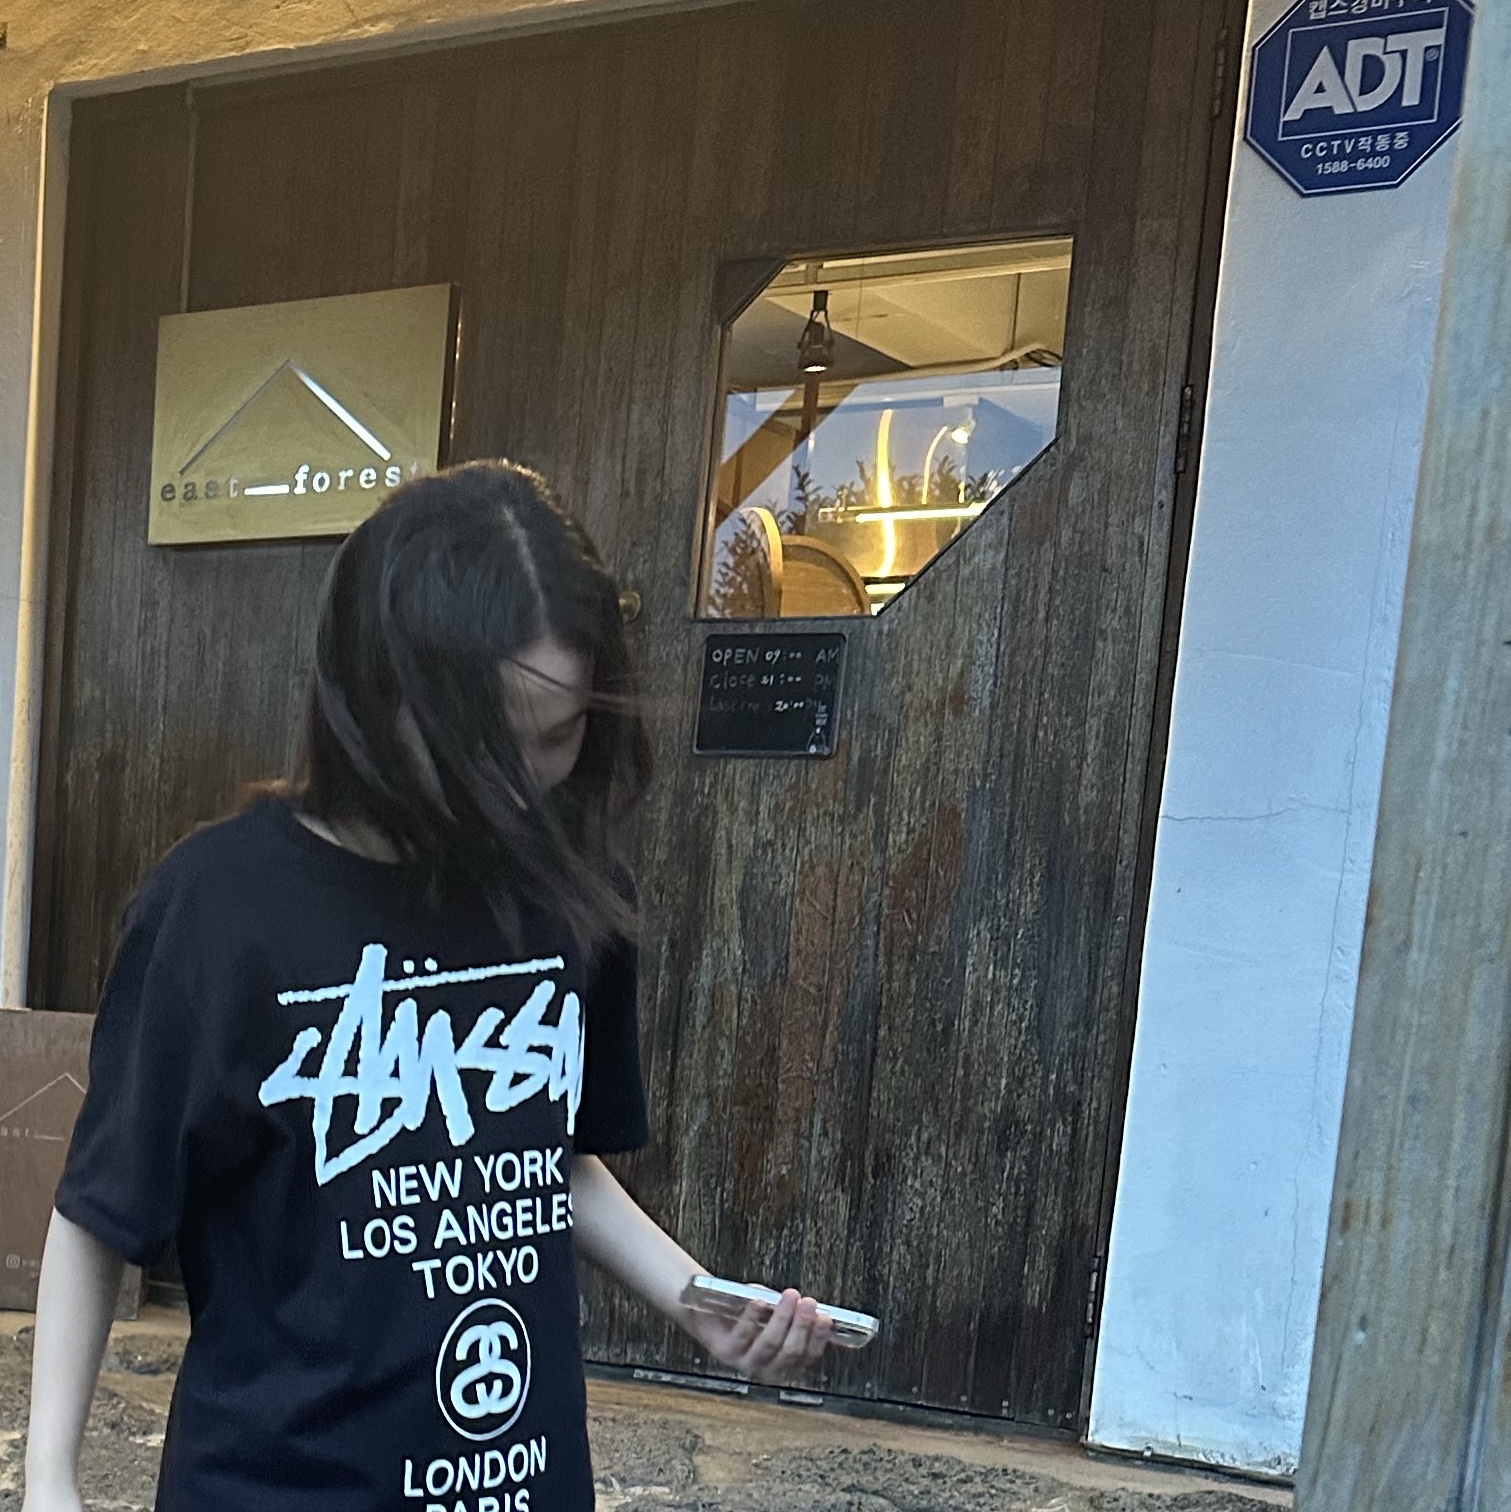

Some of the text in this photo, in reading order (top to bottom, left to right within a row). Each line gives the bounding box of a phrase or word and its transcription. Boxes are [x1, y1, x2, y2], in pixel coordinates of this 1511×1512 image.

[1282, 27, 1446, 121] ADT
[1300, 131, 1410, 159] CCTV작동중
[1315, 155, 1391, 175] 1588-6400
[711, 647, 760, 666] OPEN
[814, 647, 840, 664] AM
[372, 1147, 564, 1208] NEW YORK
[340, 1215, 418, 1260] LOS
[412, 1246, 539, 1299] TOKYO
[404, 1436, 547, 1497] LONDON
